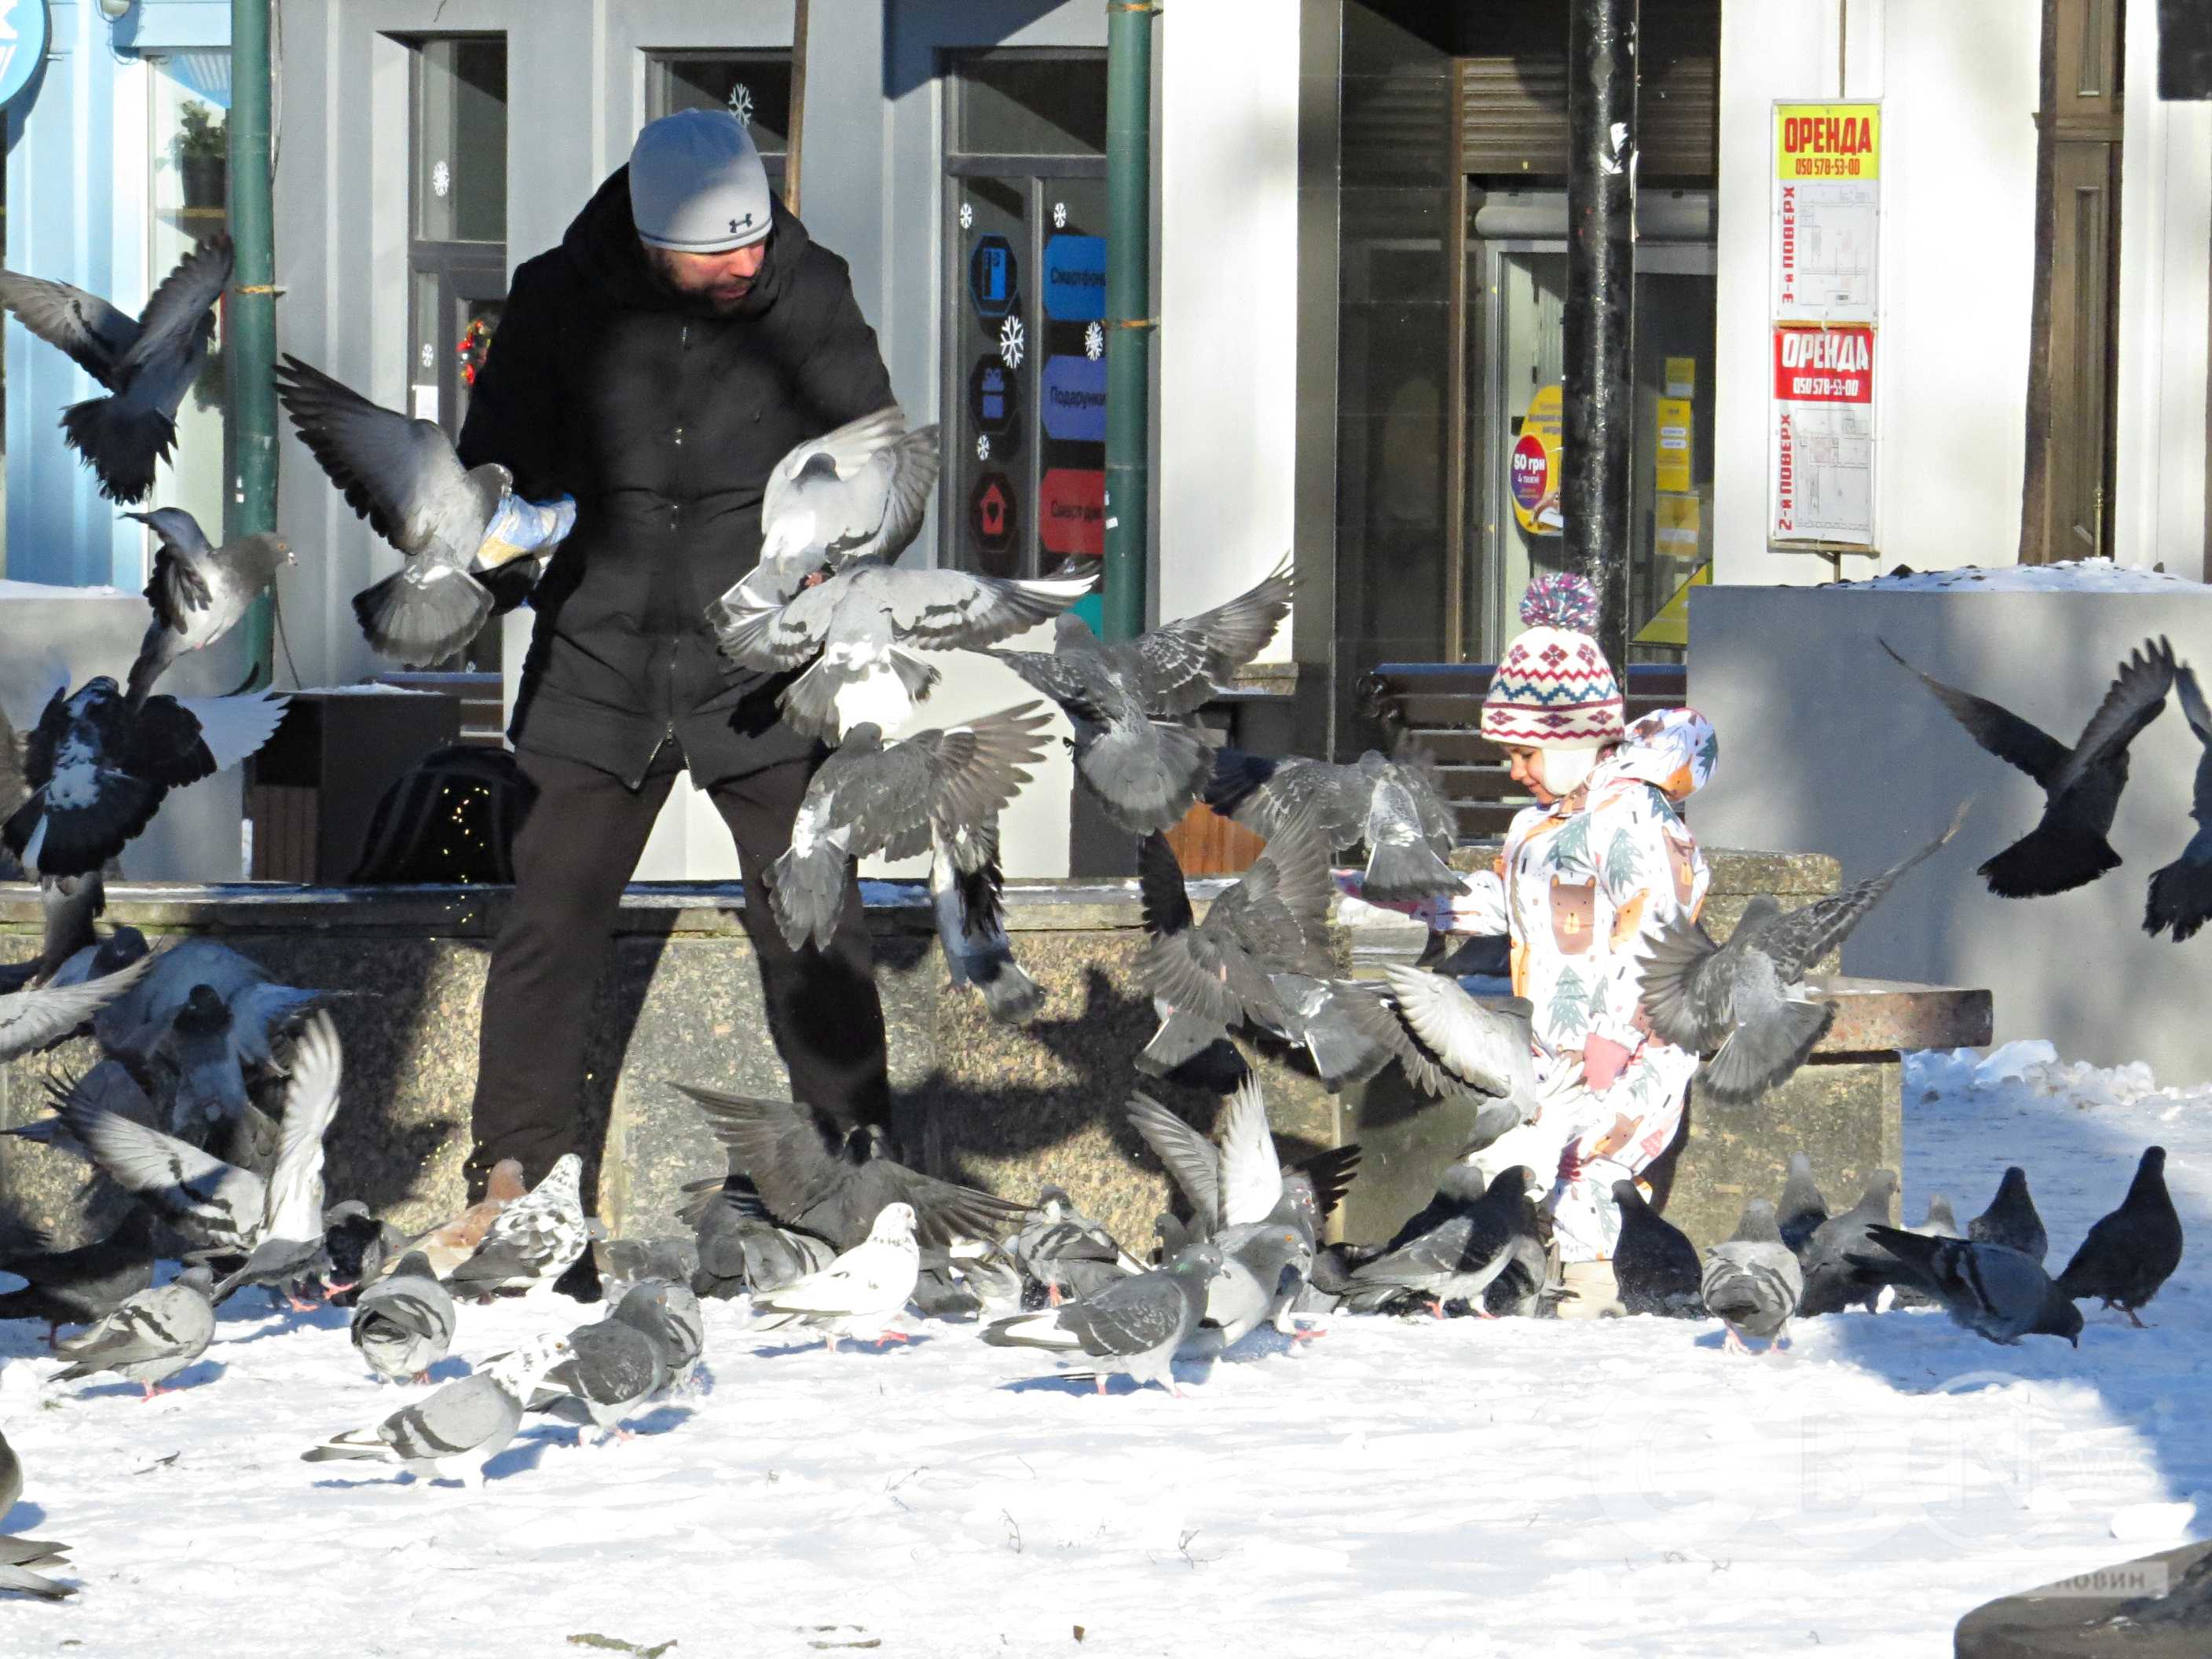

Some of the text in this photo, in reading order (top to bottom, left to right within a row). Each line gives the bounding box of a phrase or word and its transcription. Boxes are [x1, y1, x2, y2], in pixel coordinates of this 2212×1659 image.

[1784, 117, 1873, 156] ОРЕНДА
[1796, 159, 1860, 175] 050 578-53-00
[1782, 185, 1795, 269] ПОВЕРХ
[1782, 333, 1870, 372] ОРЕНДА
[1793, 377, 1812, 394] 050
[1514, 453, 1545, 474] 50 грн
[1779, 414, 1792, 494] ПОВЕРХ
